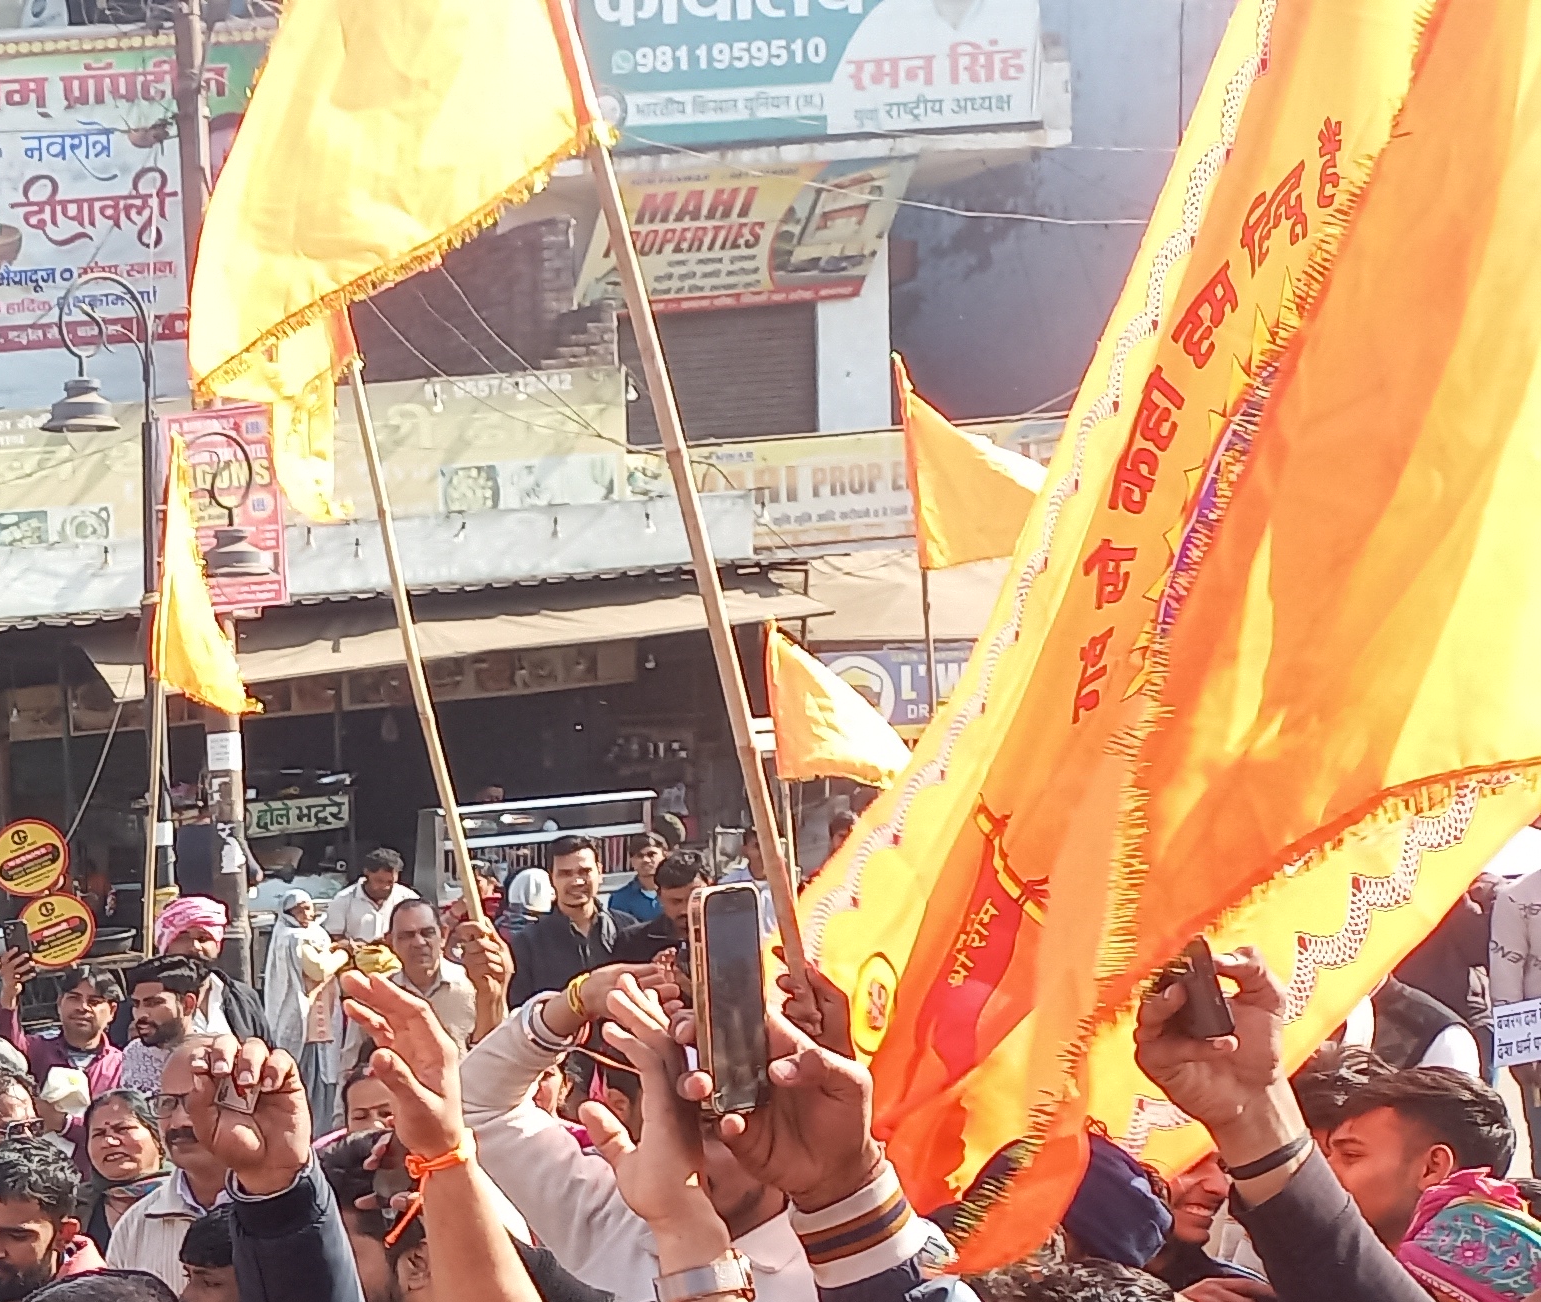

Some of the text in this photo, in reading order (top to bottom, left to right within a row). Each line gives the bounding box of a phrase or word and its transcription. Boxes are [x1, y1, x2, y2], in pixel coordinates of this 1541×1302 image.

[634, 37, 827, 75] 9811959510
[846, 39, 1029, 91] रमन सिंह
[951, 93, 1013, 117] अध्यक्ष
[8, 166, 180, 249] दीपावली
[635, 186, 759, 225] MAHI
[601, 221, 766, 259] ROPERTIES
[1082, 538, 1139, 611] से
[1170, 259, 1239, 370] हम
